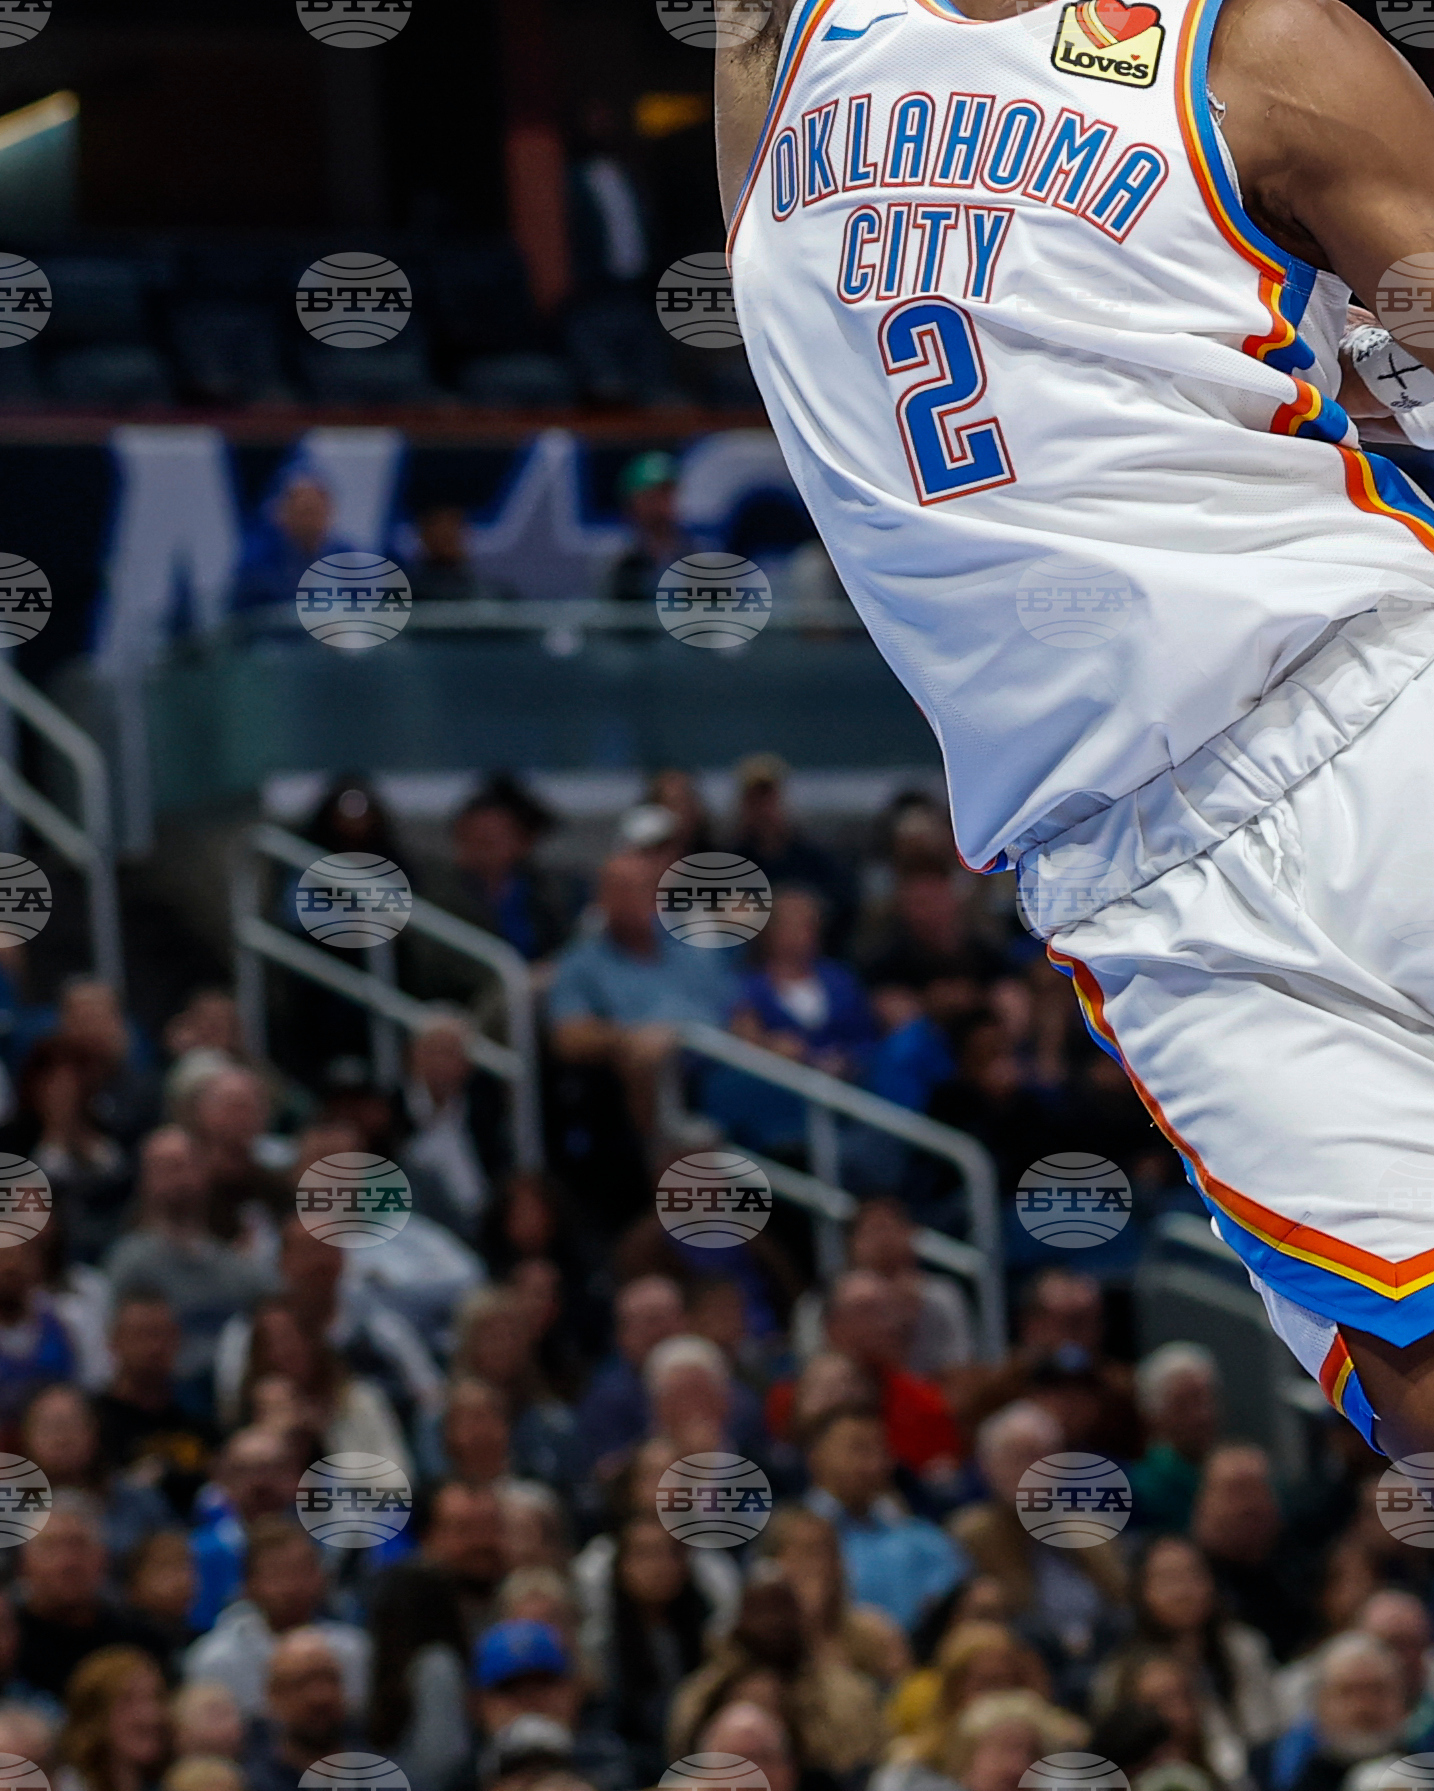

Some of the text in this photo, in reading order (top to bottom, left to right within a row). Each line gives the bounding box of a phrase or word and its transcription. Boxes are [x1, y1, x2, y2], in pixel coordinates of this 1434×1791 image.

[770, 91, 1170, 244] OKLAHOMA
[837, 202, 1015, 303] CITY
[878, 295, 1016, 506] 2
